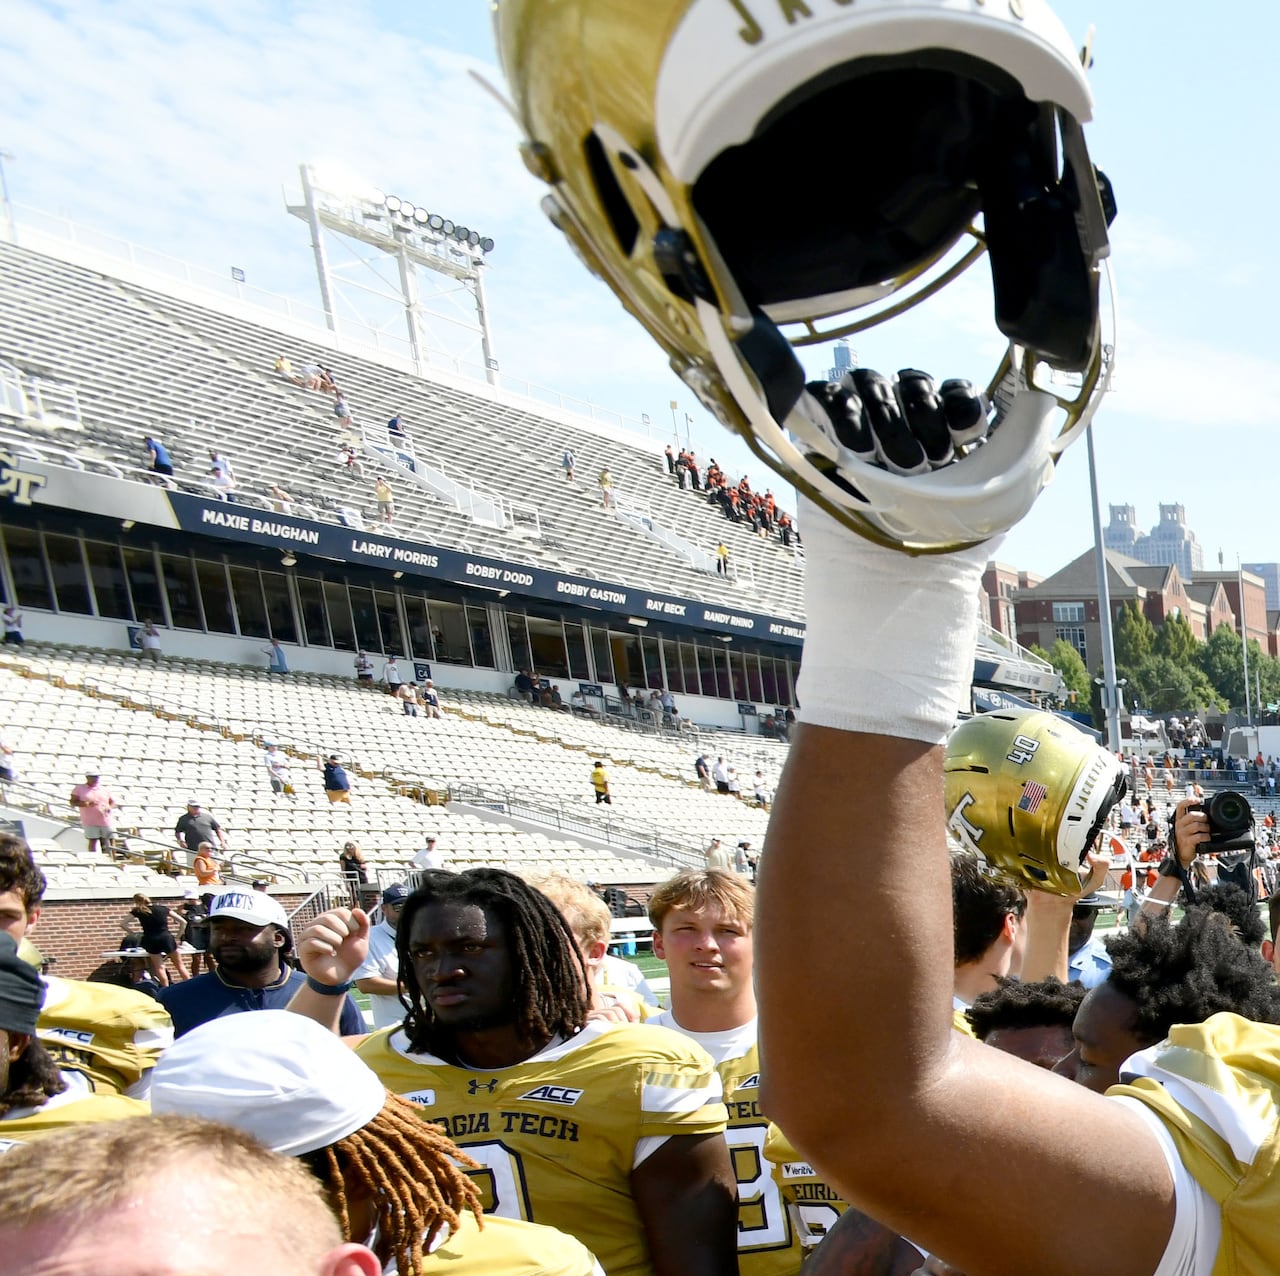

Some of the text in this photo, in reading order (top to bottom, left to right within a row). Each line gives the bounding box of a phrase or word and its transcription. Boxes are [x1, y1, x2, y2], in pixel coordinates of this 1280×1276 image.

[202, 509, 320, 545] MAXIE BAUGHAN
[351, 540, 439, 570] LARRY MORRIS
[466, 563, 534, 587] BOBBY DODD
[557, 581, 627, 605] BOBBY GASTON
[646, 599, 687, 617] RAY BECK
[703, 610, 754, 630] RANDY RHINO
[769, 623, 783, 635] PAT
[1006, 734, 1041, 766] 40
[215, 894, 255, 911] JACKETS
[52, 1028, 93, 1044] ACC
[526, 1085, 581, 1105] ACC
[500, 1111, 580, 1142] TECH
